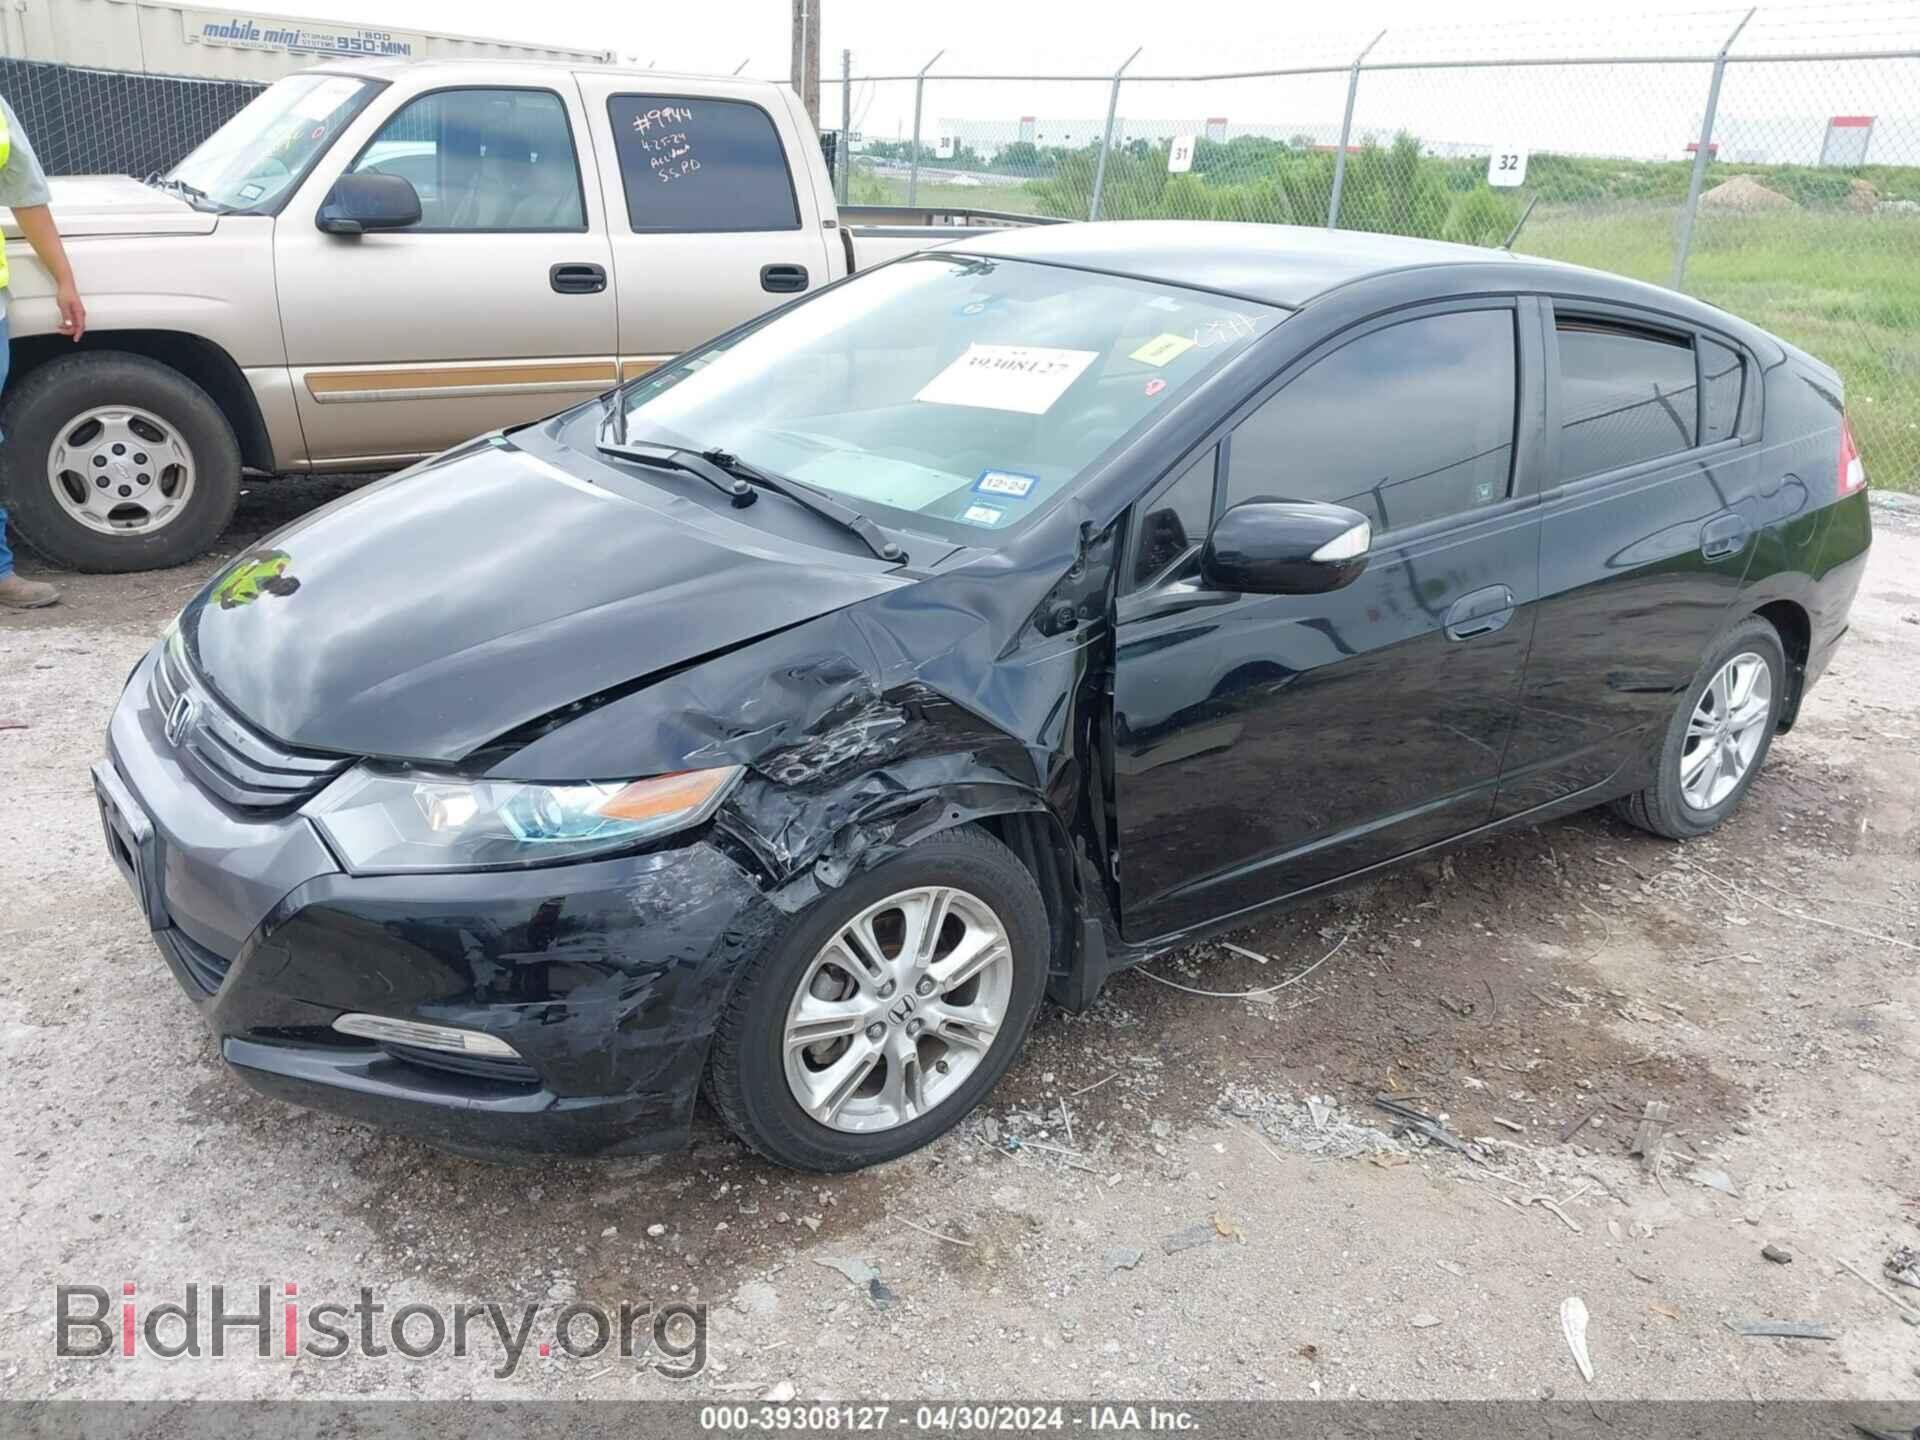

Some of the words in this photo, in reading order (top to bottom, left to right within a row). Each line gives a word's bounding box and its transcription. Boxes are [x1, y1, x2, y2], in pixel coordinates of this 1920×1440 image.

[203, 19, 260, 41] mobile
[264, 28, 300, 45] mini
[1175, 147, 1188, 160] 31
[1499, 154, 1519, 170] 32
